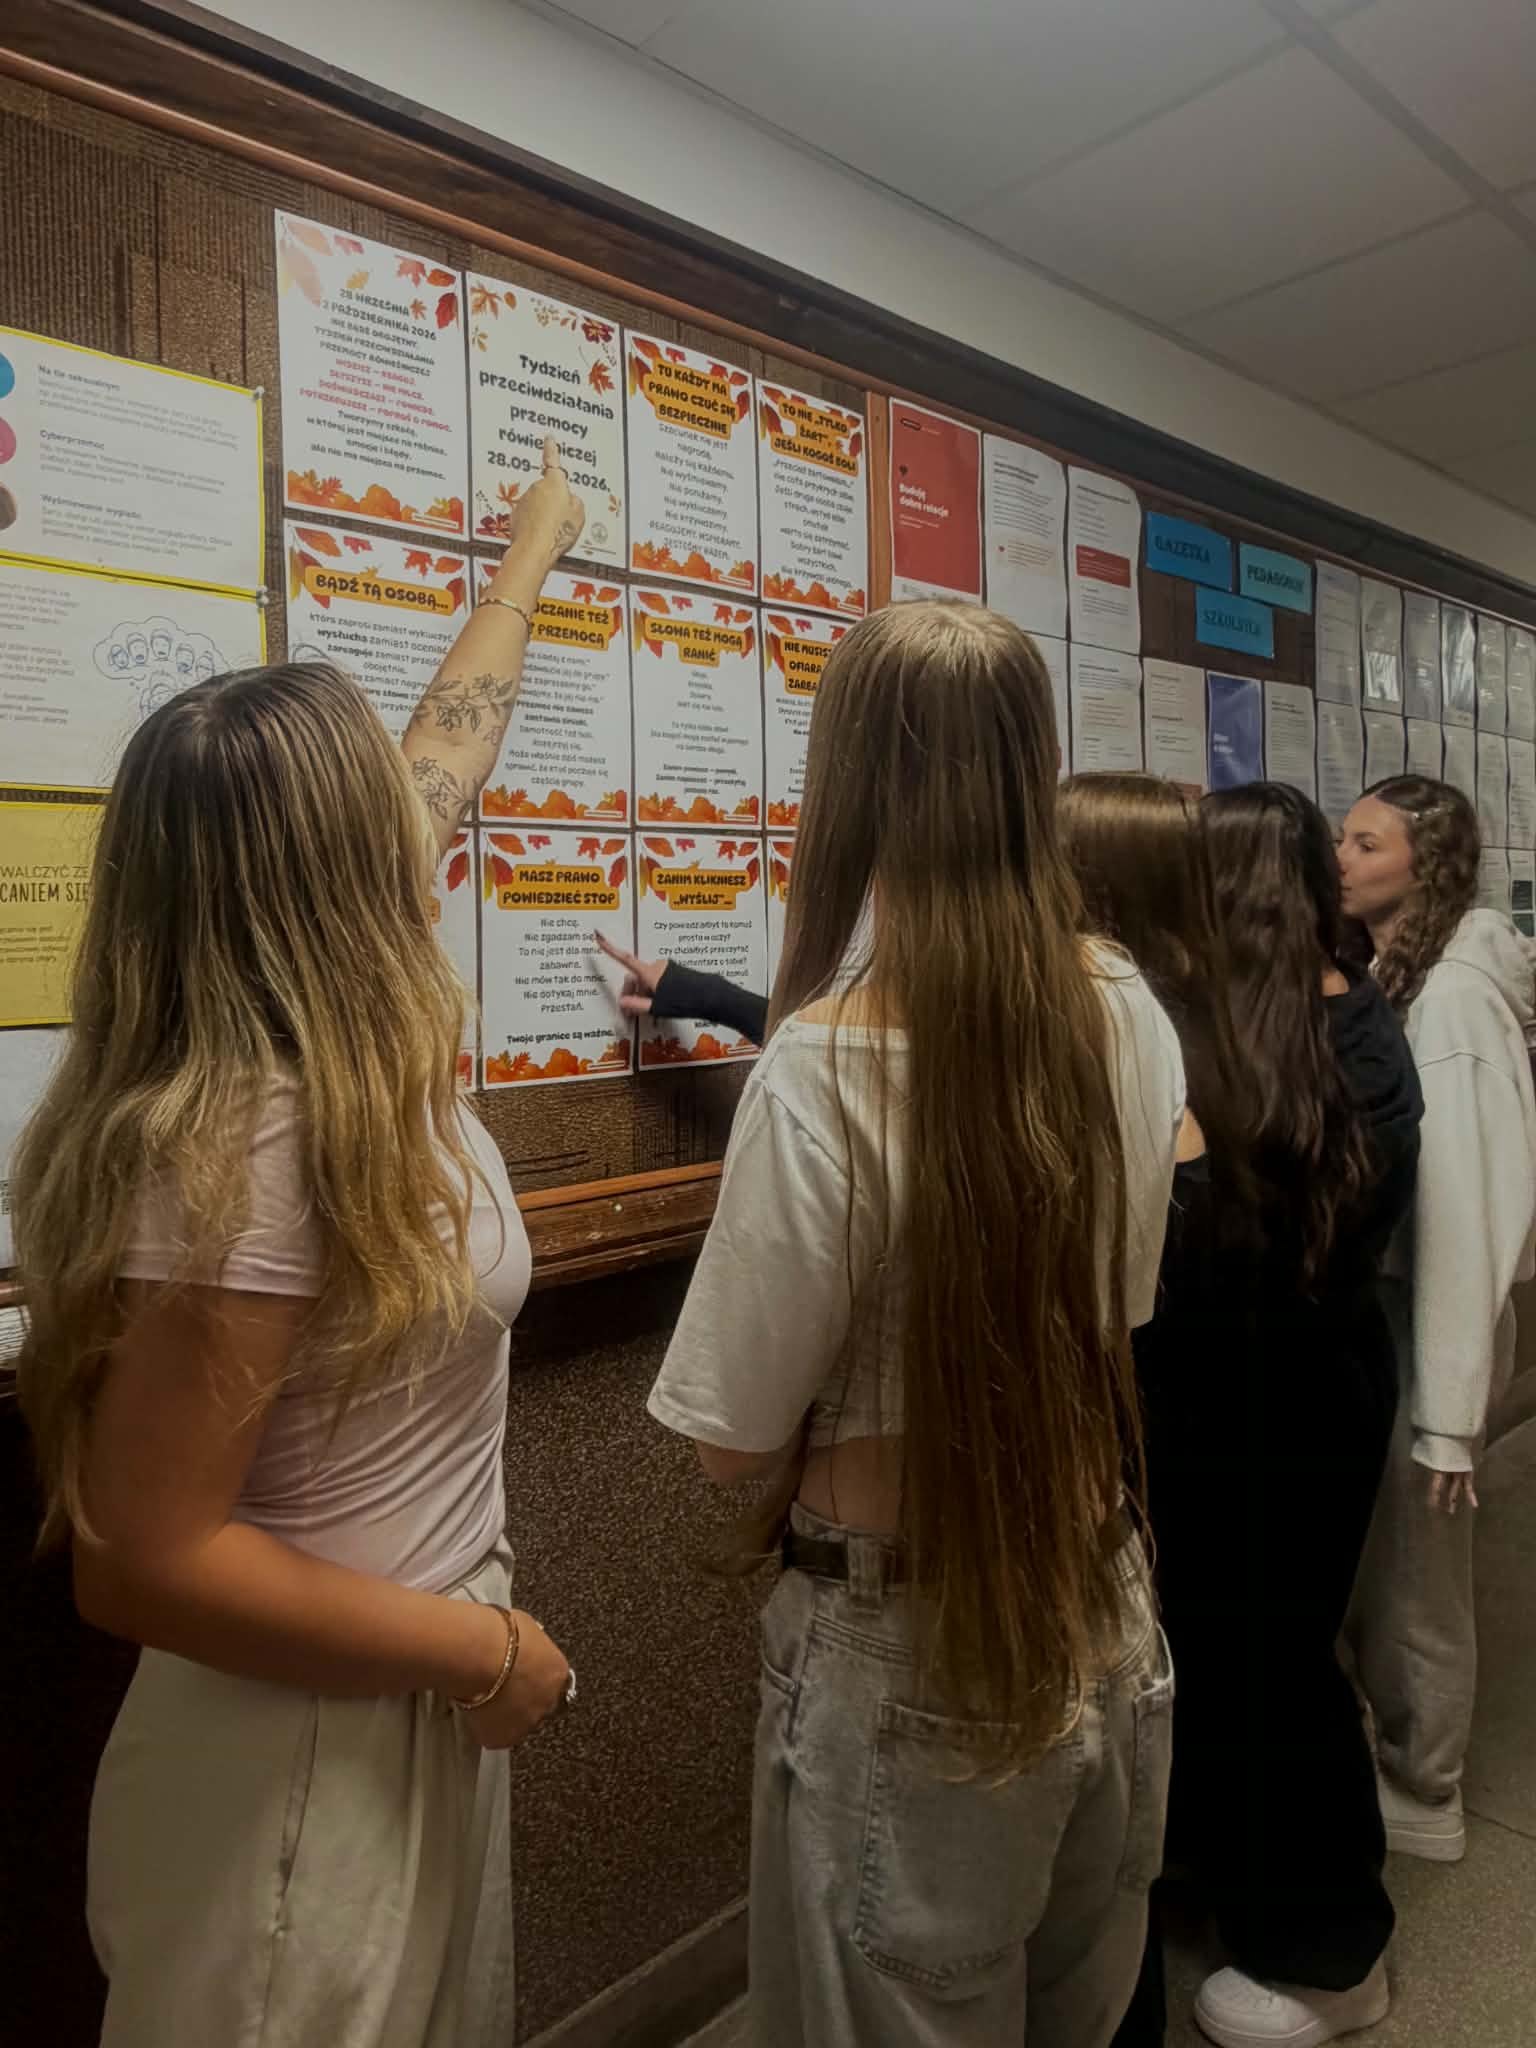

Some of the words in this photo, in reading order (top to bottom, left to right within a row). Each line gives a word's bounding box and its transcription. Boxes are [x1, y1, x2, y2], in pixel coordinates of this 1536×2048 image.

[411, 326, 437, 341] 2026
[519, 354, 581, 385] Tydzień
[658, 364, 672, 377] TU
[674, 369, 711, 391] KAŻDY
[712, 382, 727, 397] MA
[479, 370, 615, 420] przeciwdziałania
[648, 381, 689, 402] PRAWO
[690, 394, 719, 412] CZUĆ
[720, 404, 736, 421] SIĘ
[658, 404, 727, 434] BEZPIECZNIE
[782, 402, 796, 417] TO
[798, 409, 813, 423] NIE
[510, 404, 589, 440] przemocy
[498, 428, 597, 468] rówieniczej
[774, 438, 801, 453] JEŚLI
[803, 446, 834, 465] KOGOŚ
[836, 456, 856, 472] BOLI
[316, 574, 359, 594] BĄDŹ
[362, 582, 382, 601] TĄ
[587, 610, 609, 625] TEŻ
[369, 636, 409, 649] zamiast
[538, 624, 605, 649] PRZEMOCĄ
[650, 622, 691, 639] SŁOWA
[692, 626, 712, 642] TEŻ
[713, 632, 743, 650] MOGĄ
[682, 646, 716, 662] RANIĆ
[784, 641, 801, 654] NIE
[802, 644, 832, 658] MUSIS
[0, 864, 70, 879] WALCZYĆ
[72, 866, 89, 878] ZE
[520, 870, 554, 883] MASZ
[556, 871, 601, 883] PRAWO
[657, 874, 692, 886] ZANIM
[694, 874, 746, 886] KLIKNIESZ
[503, 890, 583, 905] POWIEDZIEĆ
[584, 892, 616, 905] STOP
[540, 919, 555, 927] Nie
[654, 920, 668, 930] Czy
[524, 934, 539, 942] Nie
[541, 933, 581, 944] zgadzam
[519, 947, 530, 956] To
[531, 947, 545, 956] nie
[546, 946, 564, 958] jest
[566, 946, 580, 955] dla
[515, 976, 529, 985] Nie
[531, 976, 553, 985] mów
[554, 975, 570, 984] tak
[571, 975, 582, 983] do
[524, 991, 538, 1000] Nie
[540, 990, 575, 1000] dotykaj
[506, 1034, 534, 1045] Twoje
[536, 1032, 571, 1044] granice
[572, 1032, 583, 1040] są
[584, 1028, 615, 1038] ważne.
